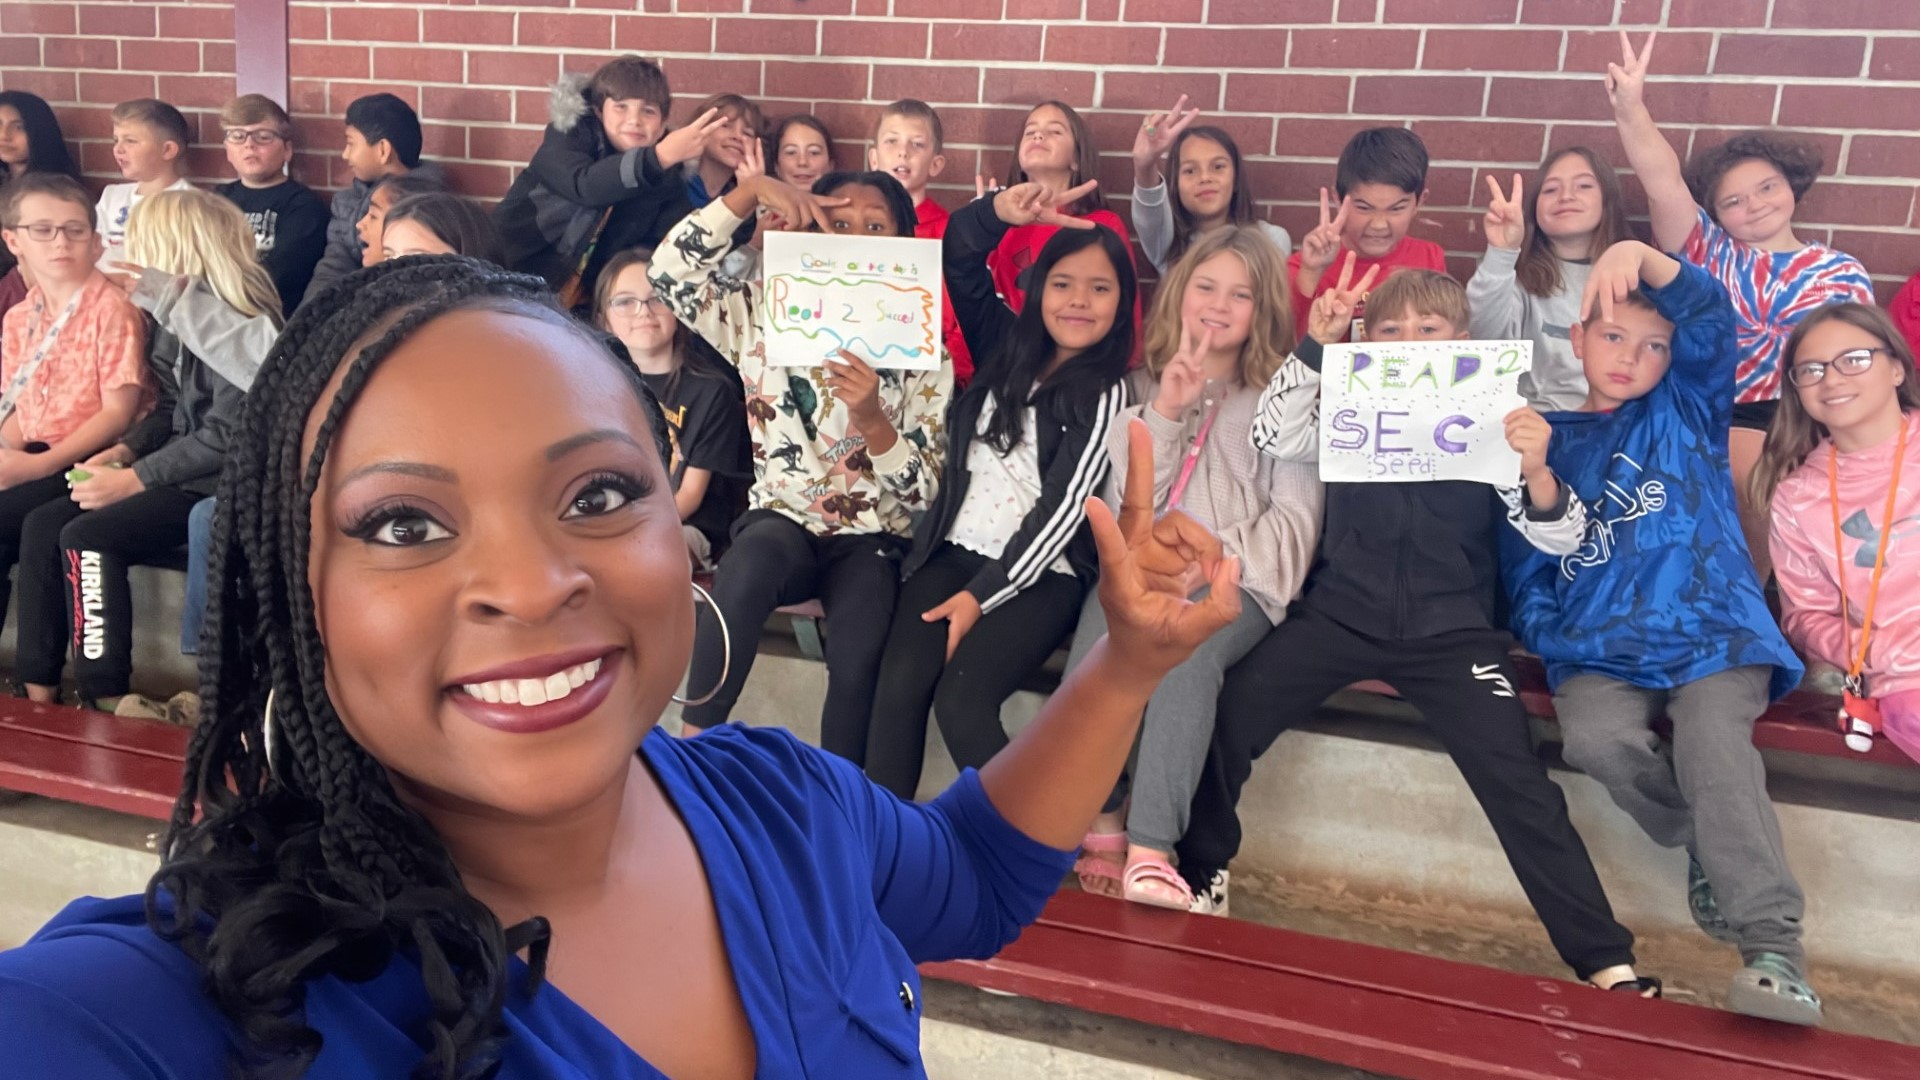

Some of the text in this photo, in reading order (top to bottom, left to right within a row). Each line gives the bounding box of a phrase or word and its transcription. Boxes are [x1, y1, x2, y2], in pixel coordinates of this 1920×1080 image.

[772, 278, 823, 323] Read
[842, 303, 861, 323] 2
[1348, 350, 1522, 393] READ 2
[1330, 408, 1476, 454] SEC
[81, 550, 104, 660] KIRKLAND
